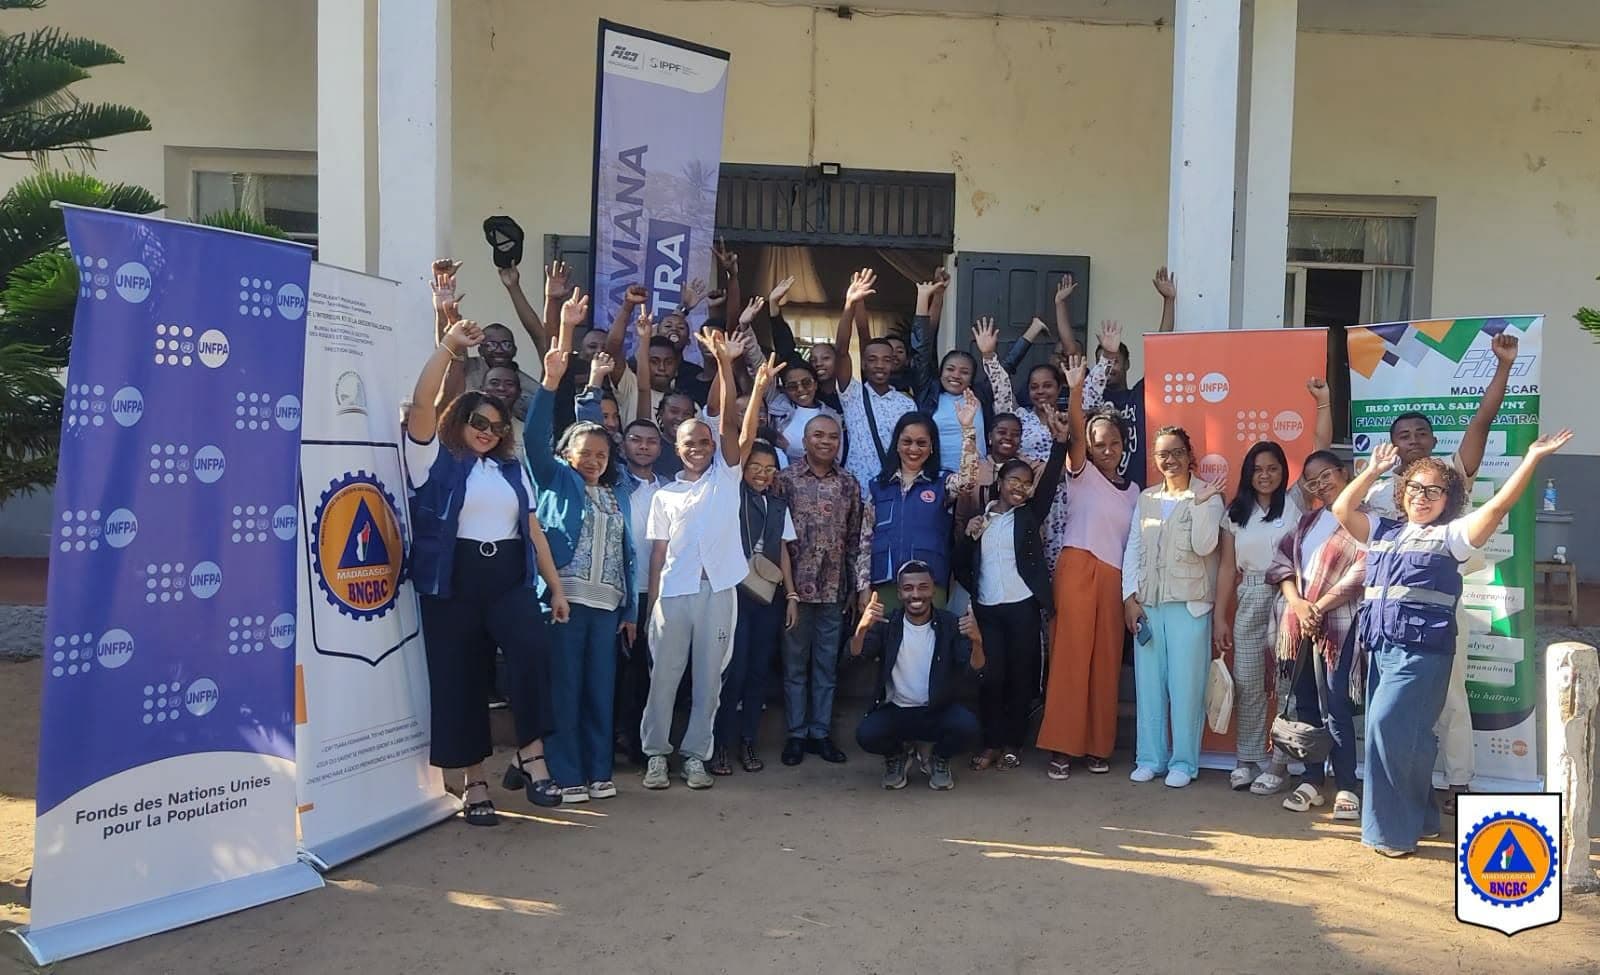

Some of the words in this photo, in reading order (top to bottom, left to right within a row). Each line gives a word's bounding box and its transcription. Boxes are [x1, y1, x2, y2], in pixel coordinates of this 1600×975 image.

[660, 60, 681, 72] IPPF
[116, 273, 151, 290] UNFPA
[278, 295, 304, 308] UNFPA
[199, 342, 228, 355] UNFPA
[1200, 382, 1228, 392] UNFPA
[1450, 384, 1538, 396] MADASCAR
[112, 400, 143, 413] UNFPA
[1365, 404, 1390, 413] IREO
[1392, 402, 1446, 412] TOLOTRA
[1273, 421, 1302, 431] UNFPA
[194, 458, 225, 471] UNFPA
[1200, 463, 1228, 473] UNFPA
[105, 520, 137, 535] UNFPA
[190, 572, 221, 587] UNFPA
[347, 579, 389, 605] BNGRC
[98, 640, 134, 656] UNFPA
[186, 688, 218, 704] UNFPA
[75, 802, 129, 825] Fonds
[133, 797, 163, 813] des
[167, 786, 226, 806] Nations
[230, 775, 271, 794] Unies
[103, 819, 142, 840] pour
[147, 814, 161, 828] la
[167, 797, 248, 824] Population
